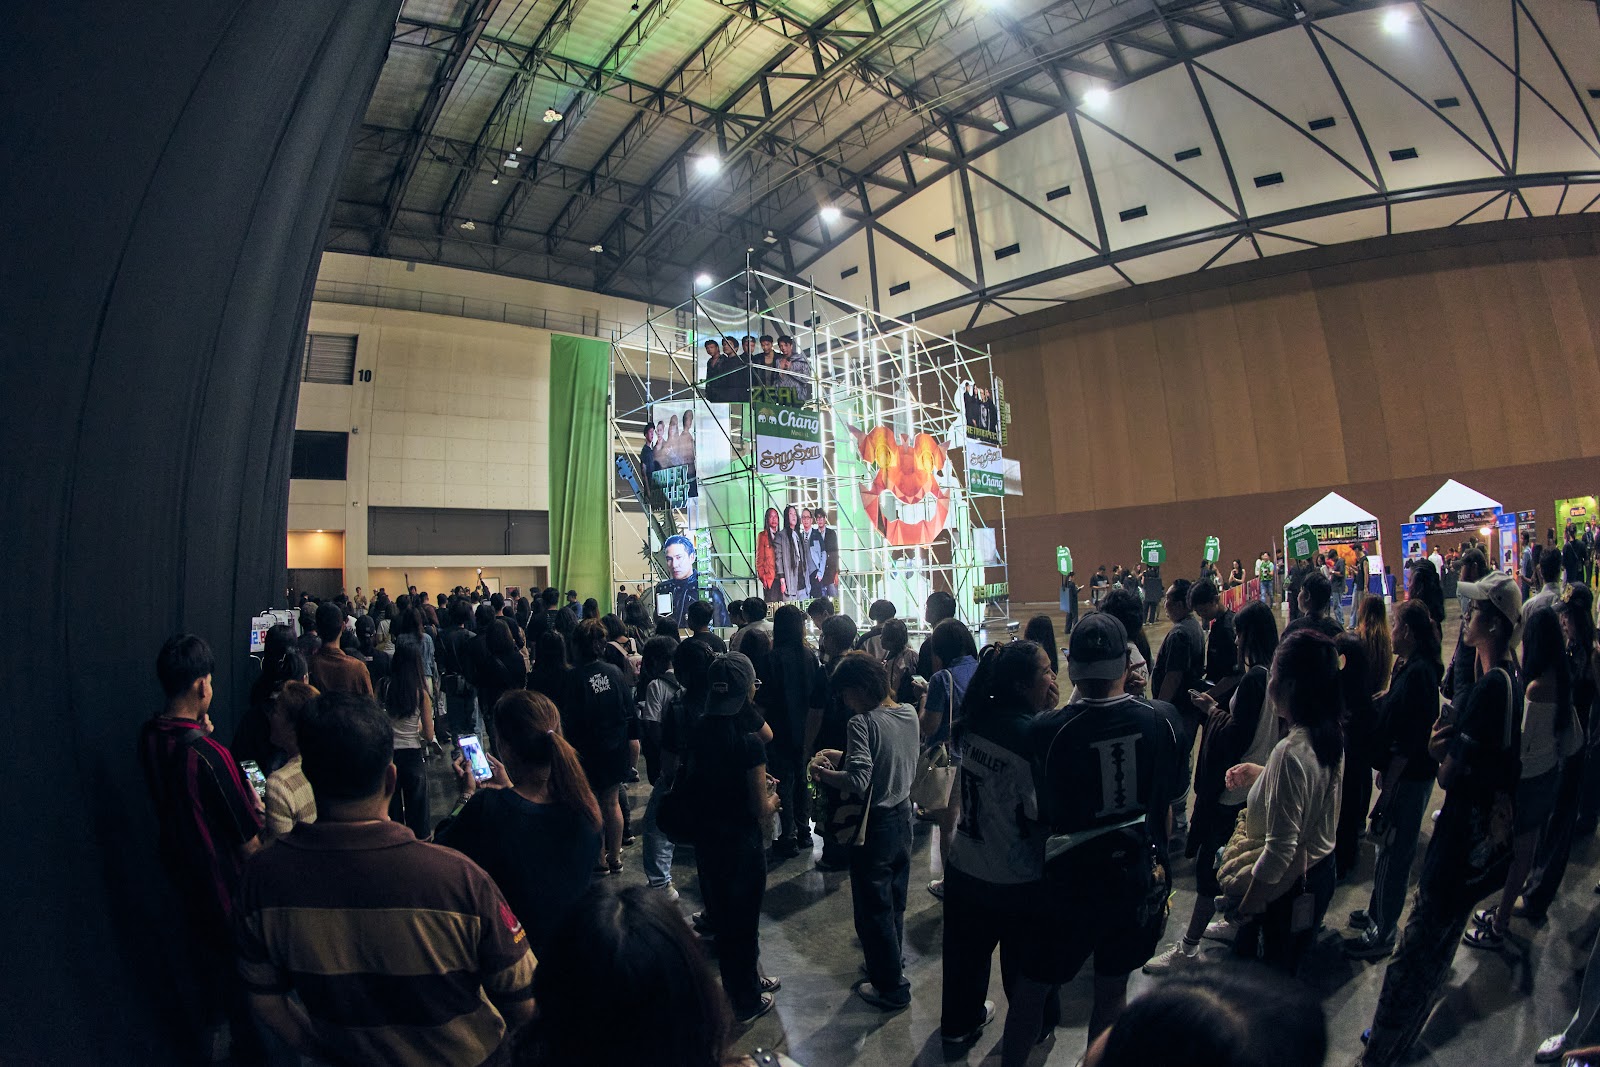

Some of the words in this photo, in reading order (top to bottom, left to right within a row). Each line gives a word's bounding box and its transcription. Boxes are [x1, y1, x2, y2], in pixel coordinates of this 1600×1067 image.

[358, 369, 372, 382] 10
[752, 386, 803, 404] ZEAL
[778, 409, 819, 434] Chang
[652, 465, 688, 487] SWEET
[982, 474, 1003, 490] Chang
[1328, 525, 1357, 539] HOUSE
[591, 675, 609, 690] KING
[970, 746, 1008, 774] MULLET
